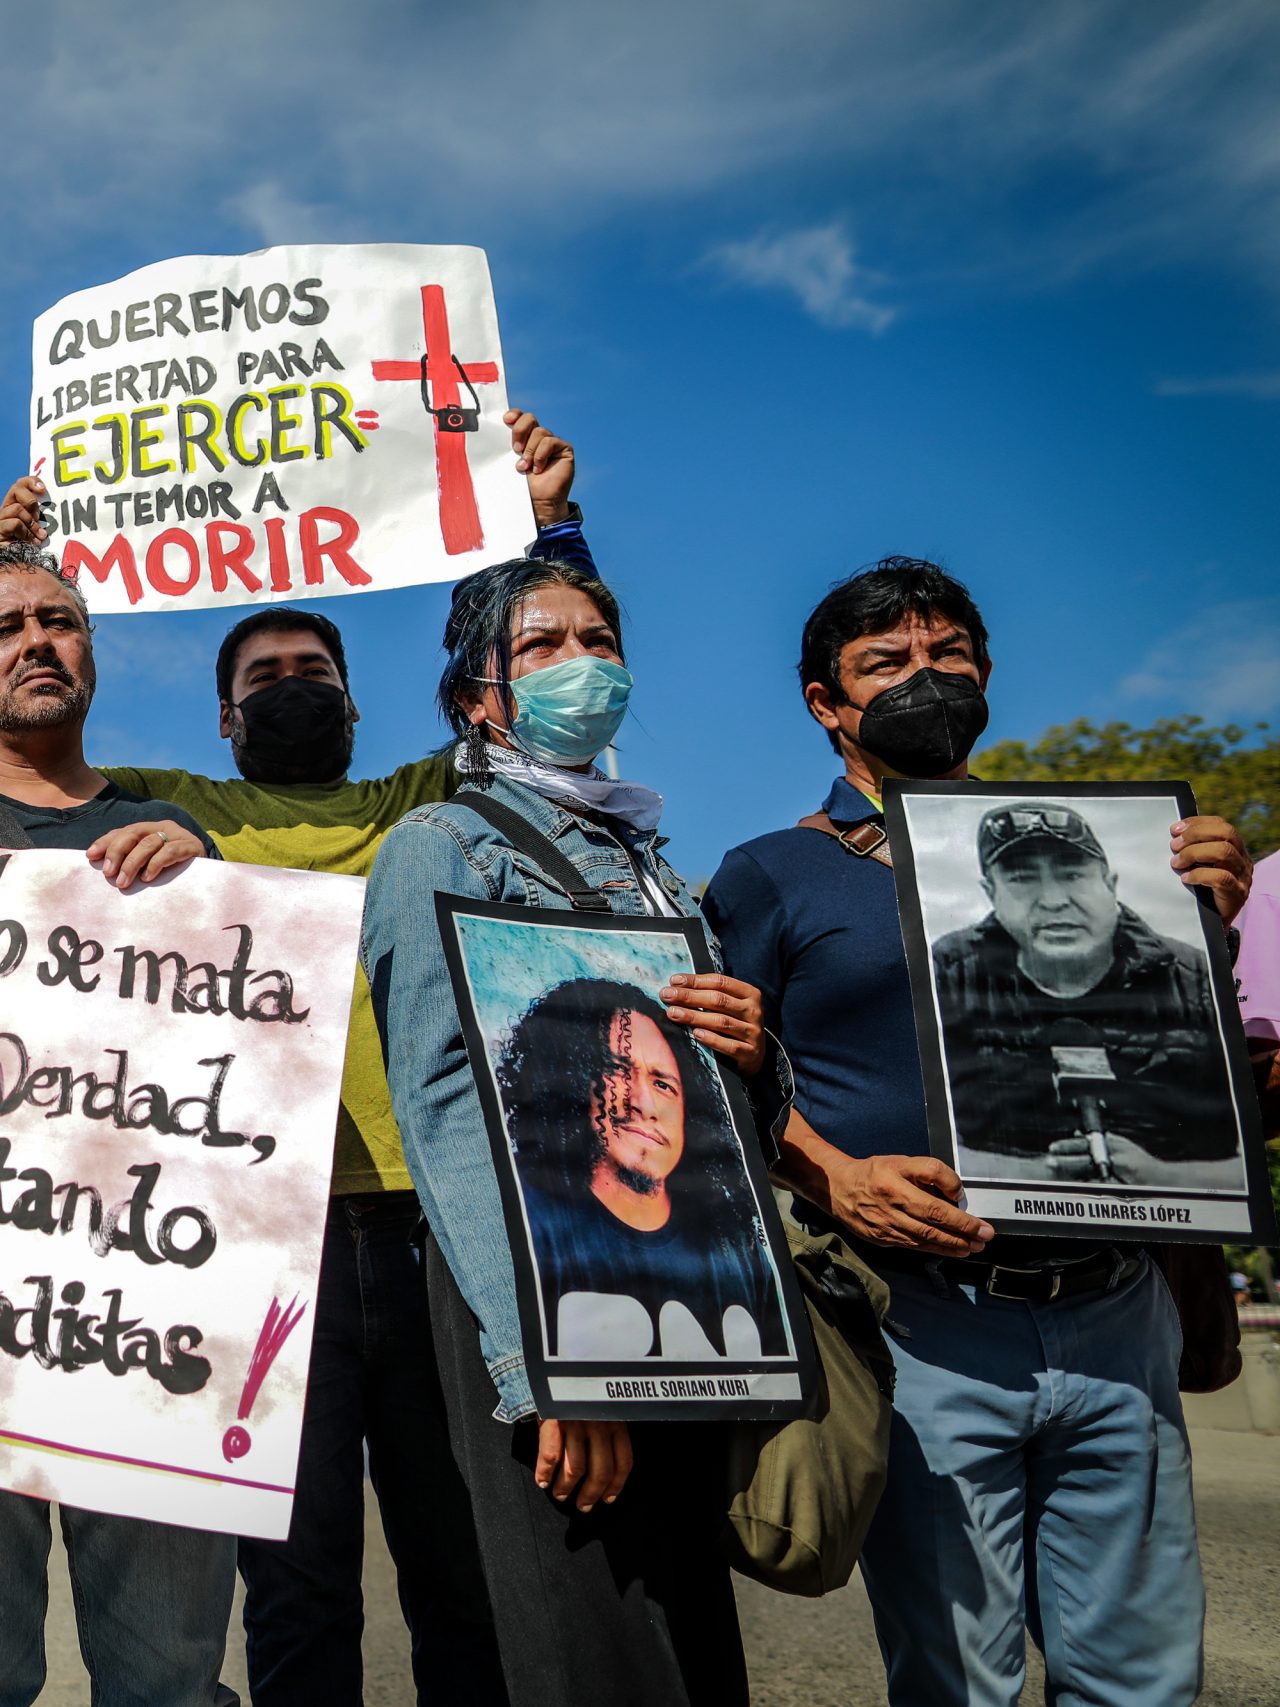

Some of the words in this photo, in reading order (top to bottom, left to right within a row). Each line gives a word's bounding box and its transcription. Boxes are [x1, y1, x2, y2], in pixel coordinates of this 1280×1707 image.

[49, 278, 329, 365] QUEREMOS
[36, 355, 218, 429] LIBERTAD
[238, 338, 345, 385] PARA
[51, 383, 370, 487] EJERCER
[40, 495, 98, 537] SIN
[104, 480, 241, 528] TEMOR
[253, 472, 290, 512] A
[61, 506, 372, 605] MORIR
[37, 925, 103, 993] se
[114, 924, 310, 1024] mata
[1014, 1199, 1085, 1217] ARMANDO
[1088, 1204, 1147, 1221] LINARES
[1150, 1204, 1191, 1223] LÓPEZ
[606, 1381, 659, 1399] GABRIEL
[661, 1380, 716, 1398] SORIANO
[718, 1379, 750, 1396] KURI
